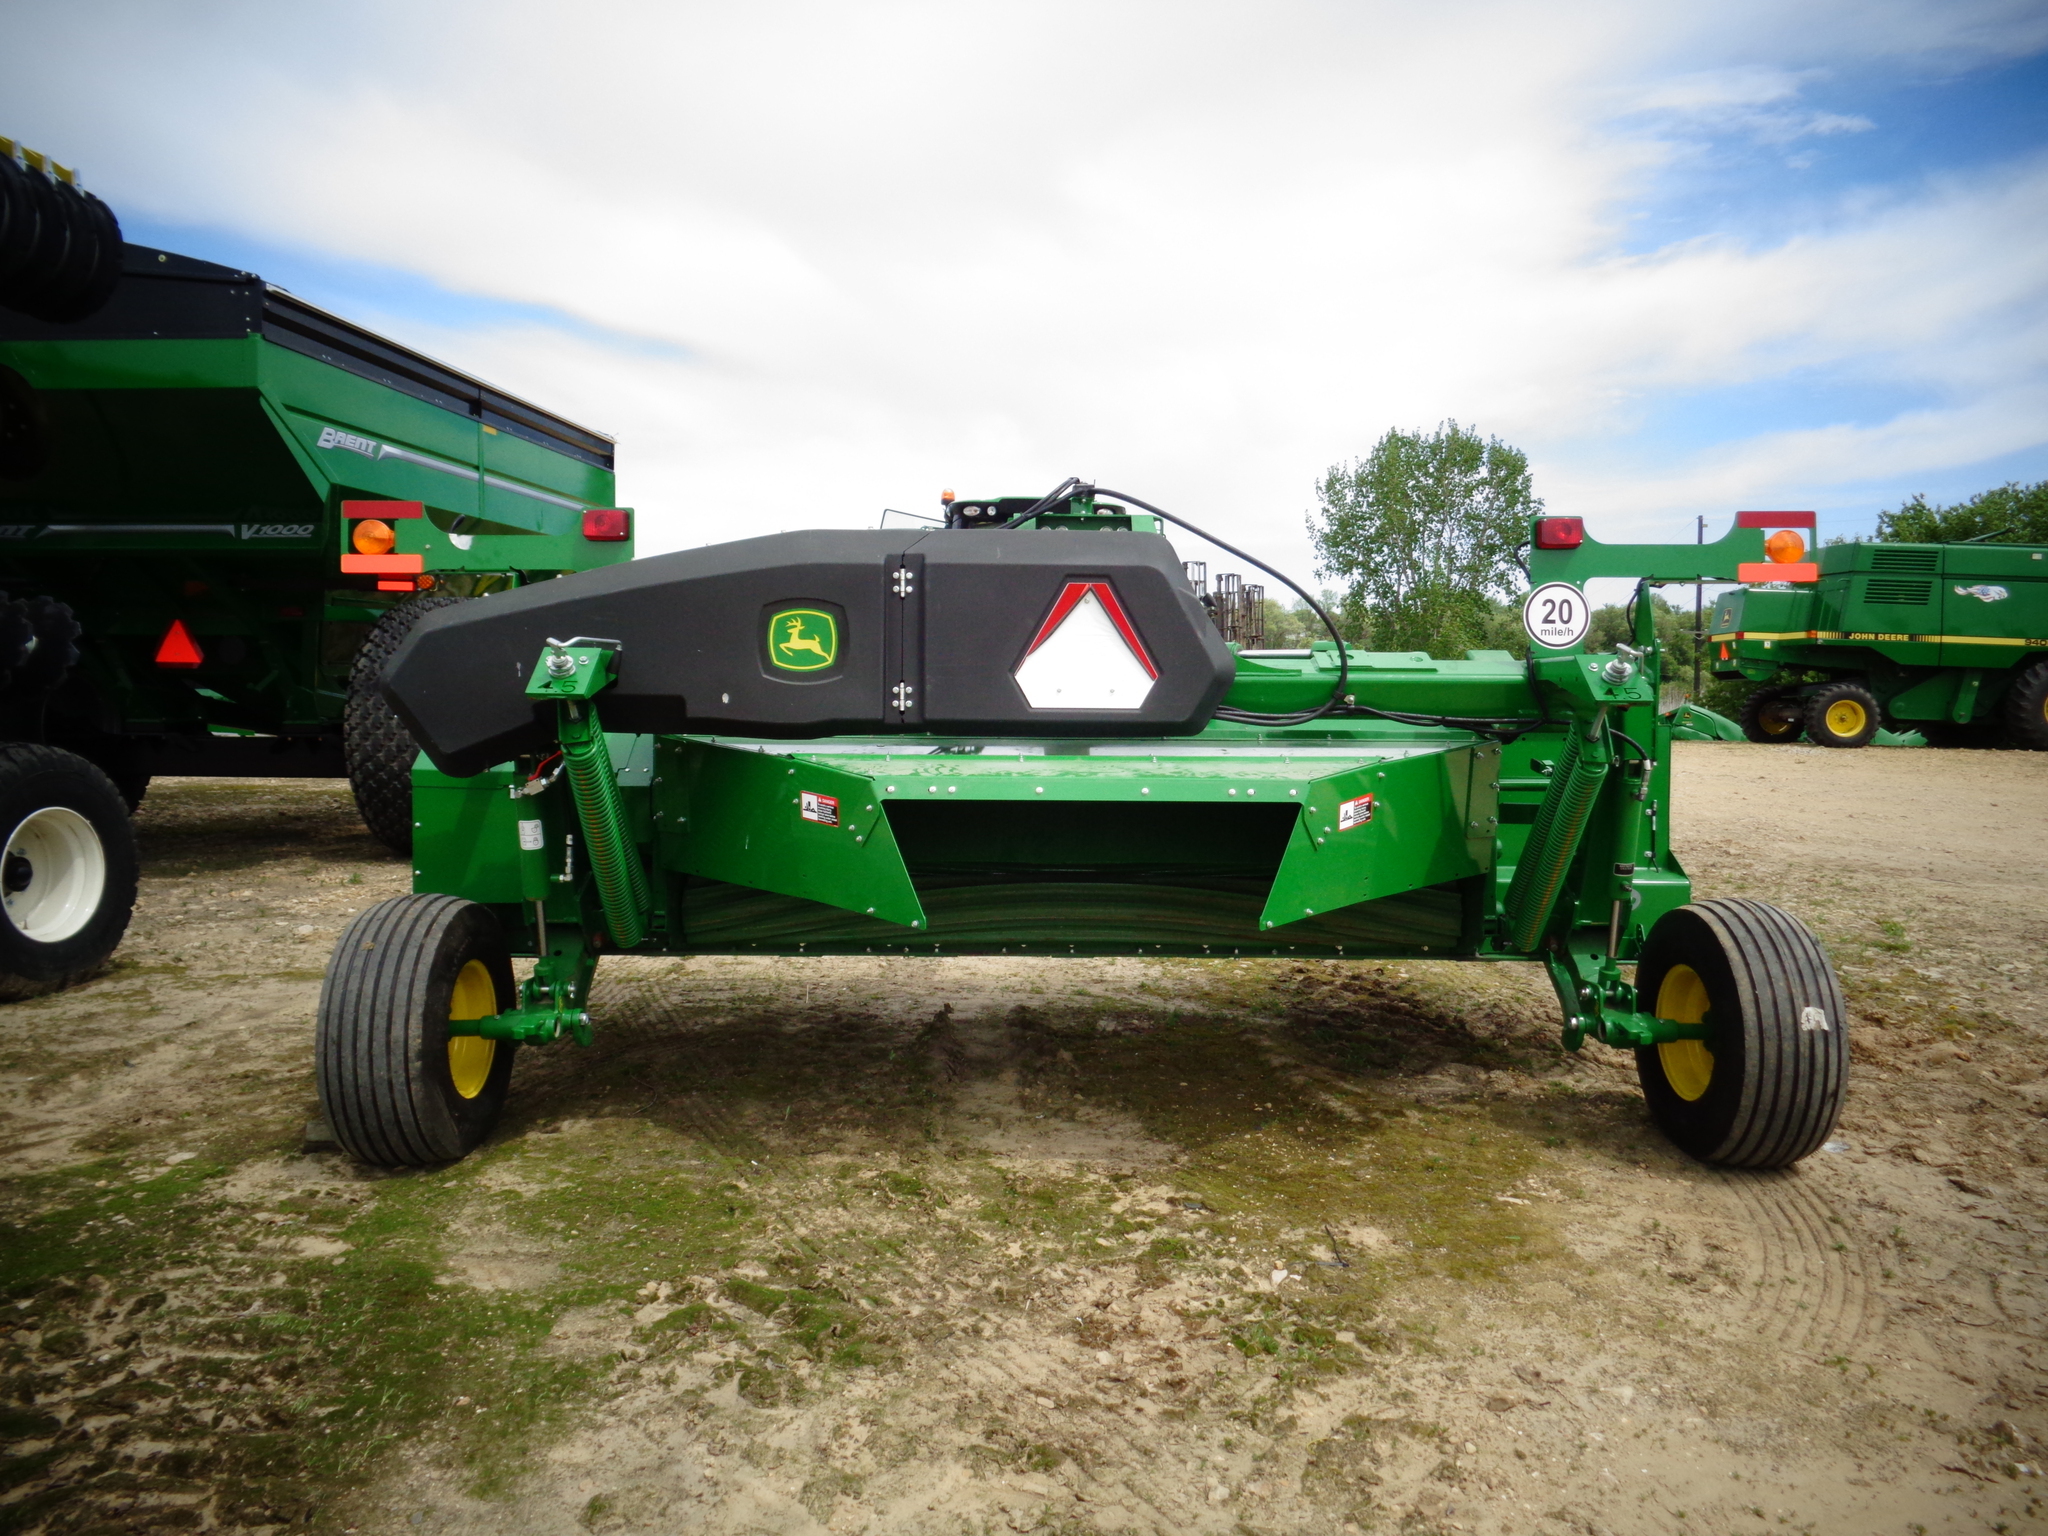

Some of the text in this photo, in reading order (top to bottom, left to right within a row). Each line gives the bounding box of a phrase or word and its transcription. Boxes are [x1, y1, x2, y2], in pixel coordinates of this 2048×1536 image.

[317, 427, 378, 455] BRENT
[241, 524, 315, 540] V1000
[1541, 598, 1573, 625] 20
[1540, 627, 1574, 636] mile/h
[1848, 632, 1909, 642] JOHN DEERE
